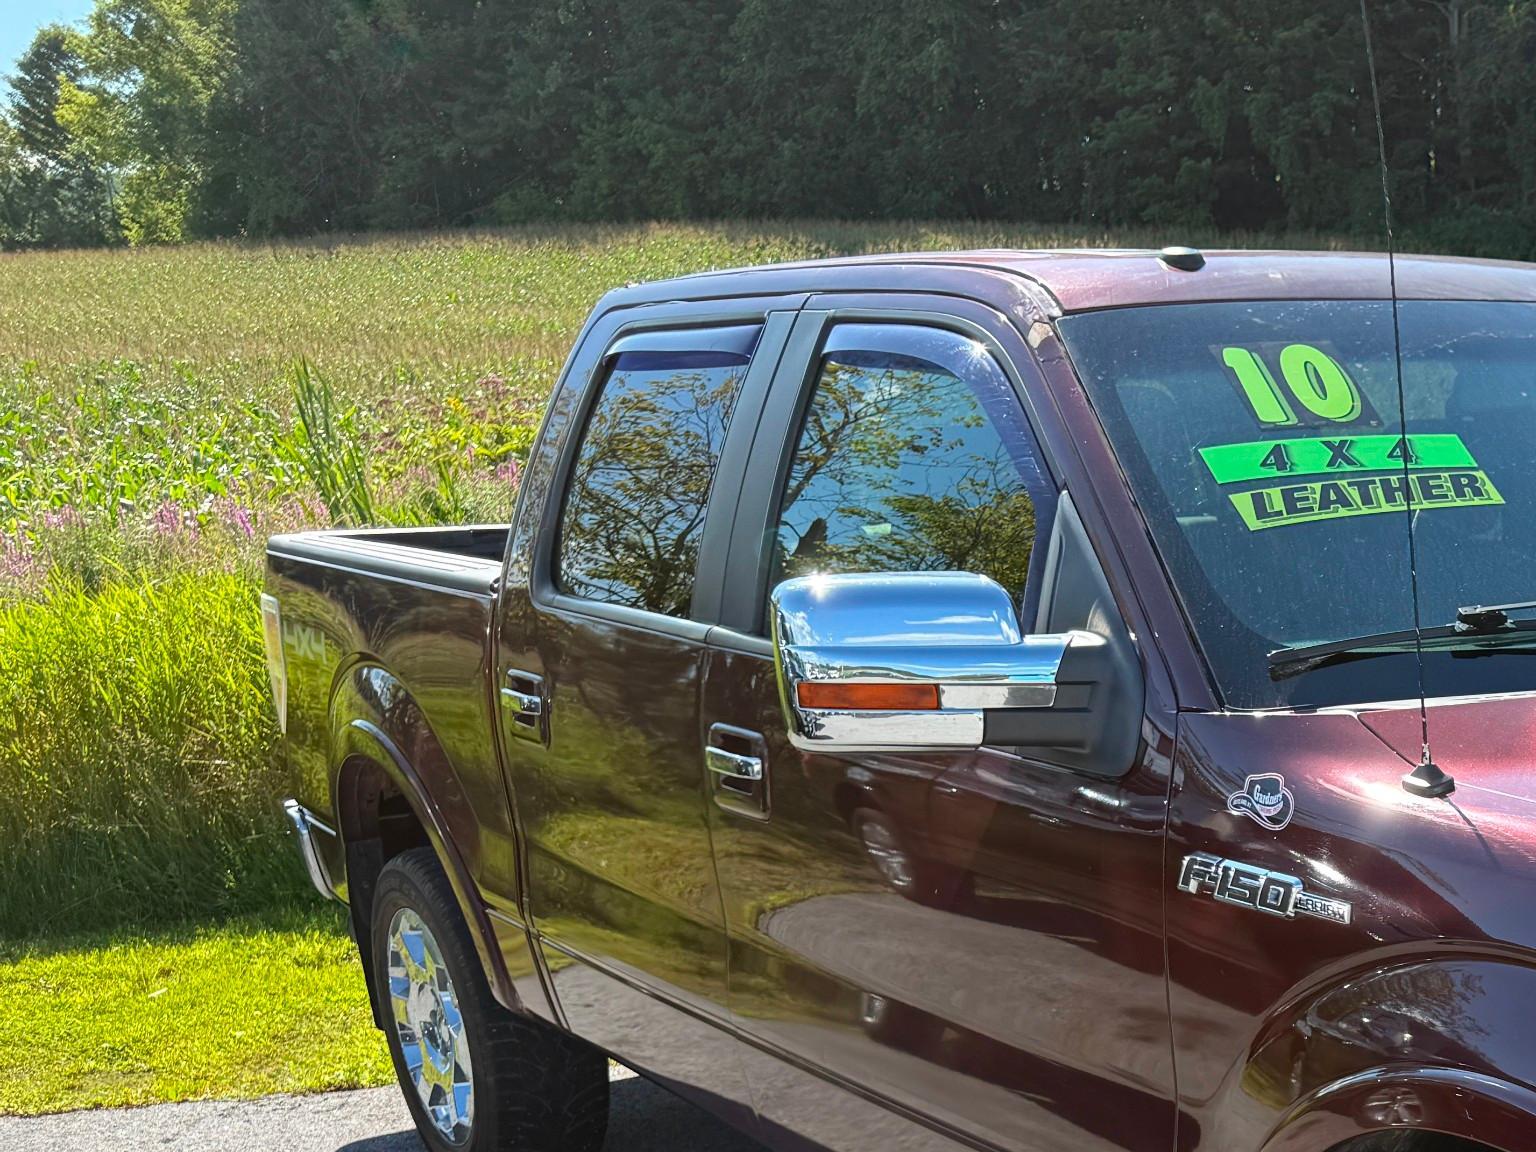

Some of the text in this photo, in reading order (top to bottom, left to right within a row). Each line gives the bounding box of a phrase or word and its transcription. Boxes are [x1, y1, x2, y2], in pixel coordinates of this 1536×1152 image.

[1222, 344, 1361, 425] 10
[1250, 473, 1494, 523] LEATHER
[283, 619, 328, 664] 4X4
[1177, 852, 1303, 919] F-150
